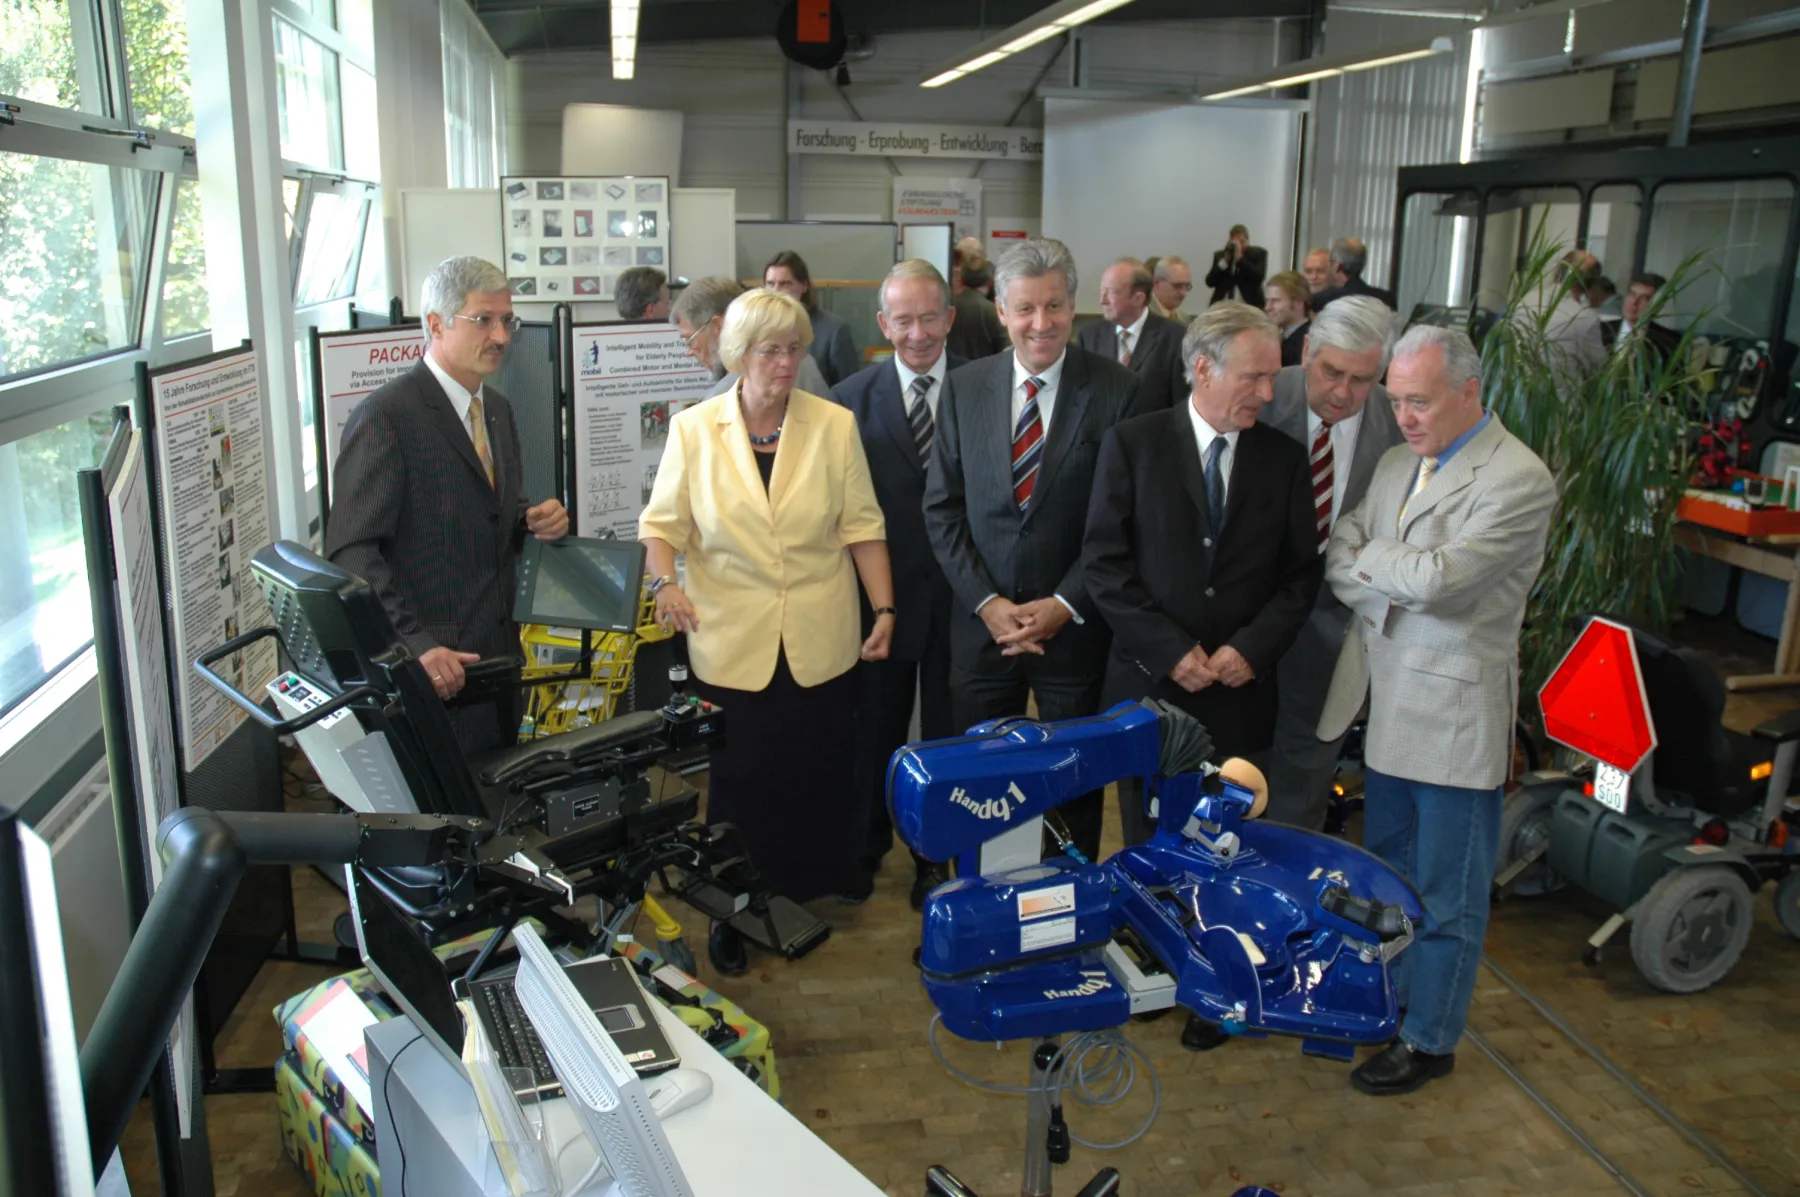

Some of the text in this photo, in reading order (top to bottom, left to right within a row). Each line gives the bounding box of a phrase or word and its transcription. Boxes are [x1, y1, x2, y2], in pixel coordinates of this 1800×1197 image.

[796, 128, 856, 152] Forschung
[869, 130, 930, 154] Erprobung
[940, 133, 1008, 157] Entwicklung
[606, 343, 637, 352] Intelligent
[638, 342, 662, 351] Mobility
[675, 340, 686, 348] Tra
[646, 352, 666, 361] Elderly
[667, 351, 688, 360] Peopl
[351, 367, 385, 379] Provision
[386, 366, 396, 375] for
[581, 367, 602, 376] mobil
[609, 365, 641, 374] Combined
[642, 364, 660, 372] Motor
[661, 363, 673, 371] and
[673, 361, 693, 369] Mental
[163, 390, 170, 399] 15
[171, 386, 185, 398] Jahre
[185, 379, 210, 394] Forschung
[211, 376, 219, 385] und
[219, 368, 243, 383] Entwicklung
[349, 381, 360, 389] via
[361, 377, 387, 388] Access
[586, 383, 616, 391] Intelligente
[605, 388, 638, 398] motorischer
[638, 387, 649, 395] und
[949, 781, 1026, 821] Handy 1
[1043, 977, 1112, 1000] Handy
